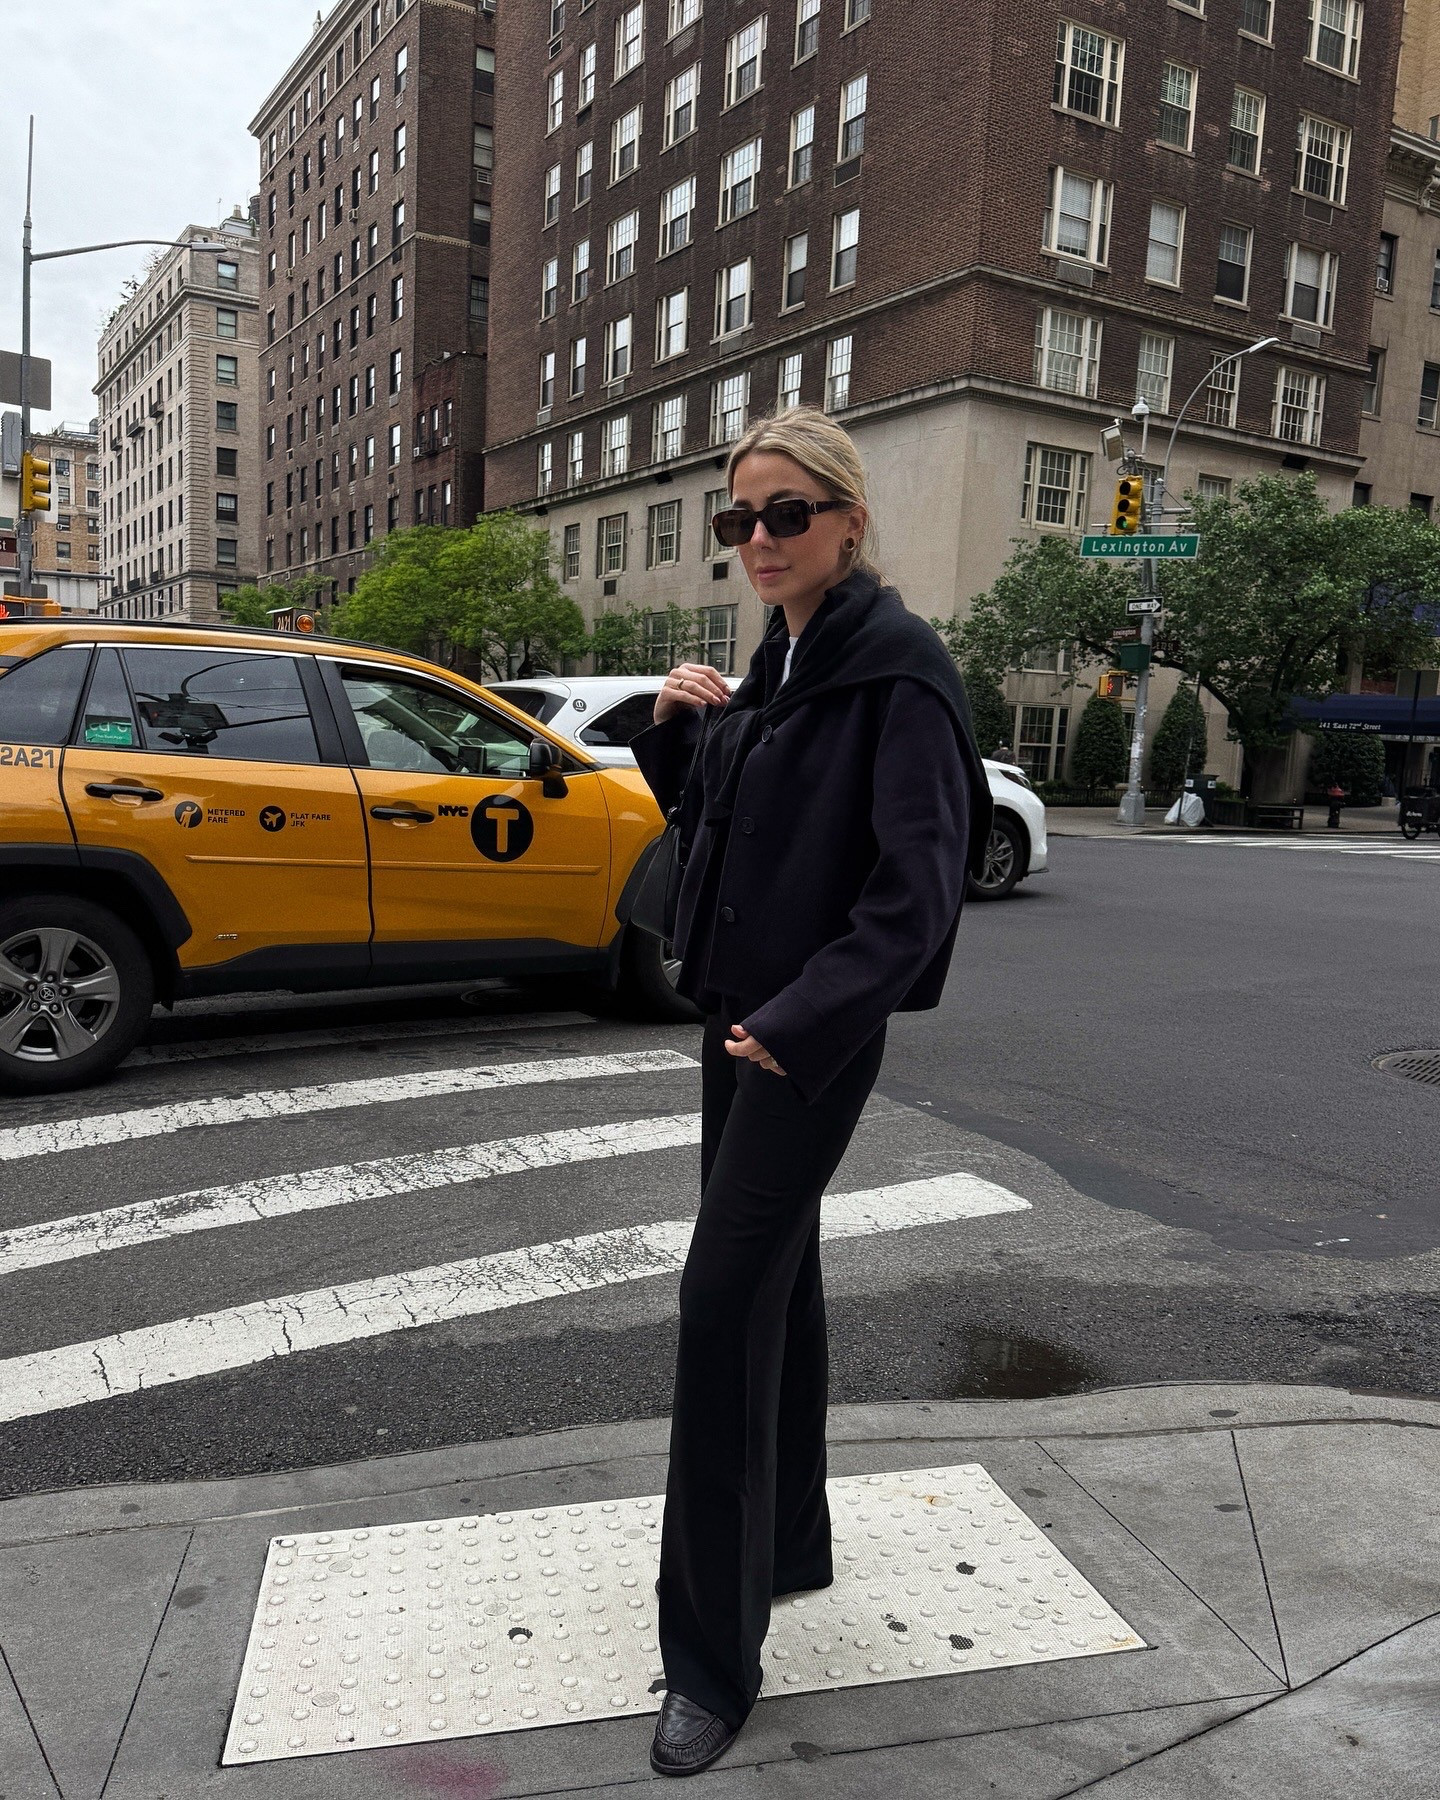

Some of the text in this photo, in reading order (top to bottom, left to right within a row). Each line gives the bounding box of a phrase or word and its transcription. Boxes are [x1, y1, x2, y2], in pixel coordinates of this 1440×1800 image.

[0, 540, 7, 551] t
[1092, 540, 1188, 555] Lexington Av
[1332, 722, 1348, 730] East
[0, 745, 55, 769] 2A21
[207, 808, 246, 817] METERED
[290, 812, 332, 821] FLAT FARE
[207, 816, 229, 824] FARE
[290, 820, 306, 828] JFK
[438, 804, 520, 853] NYC T
